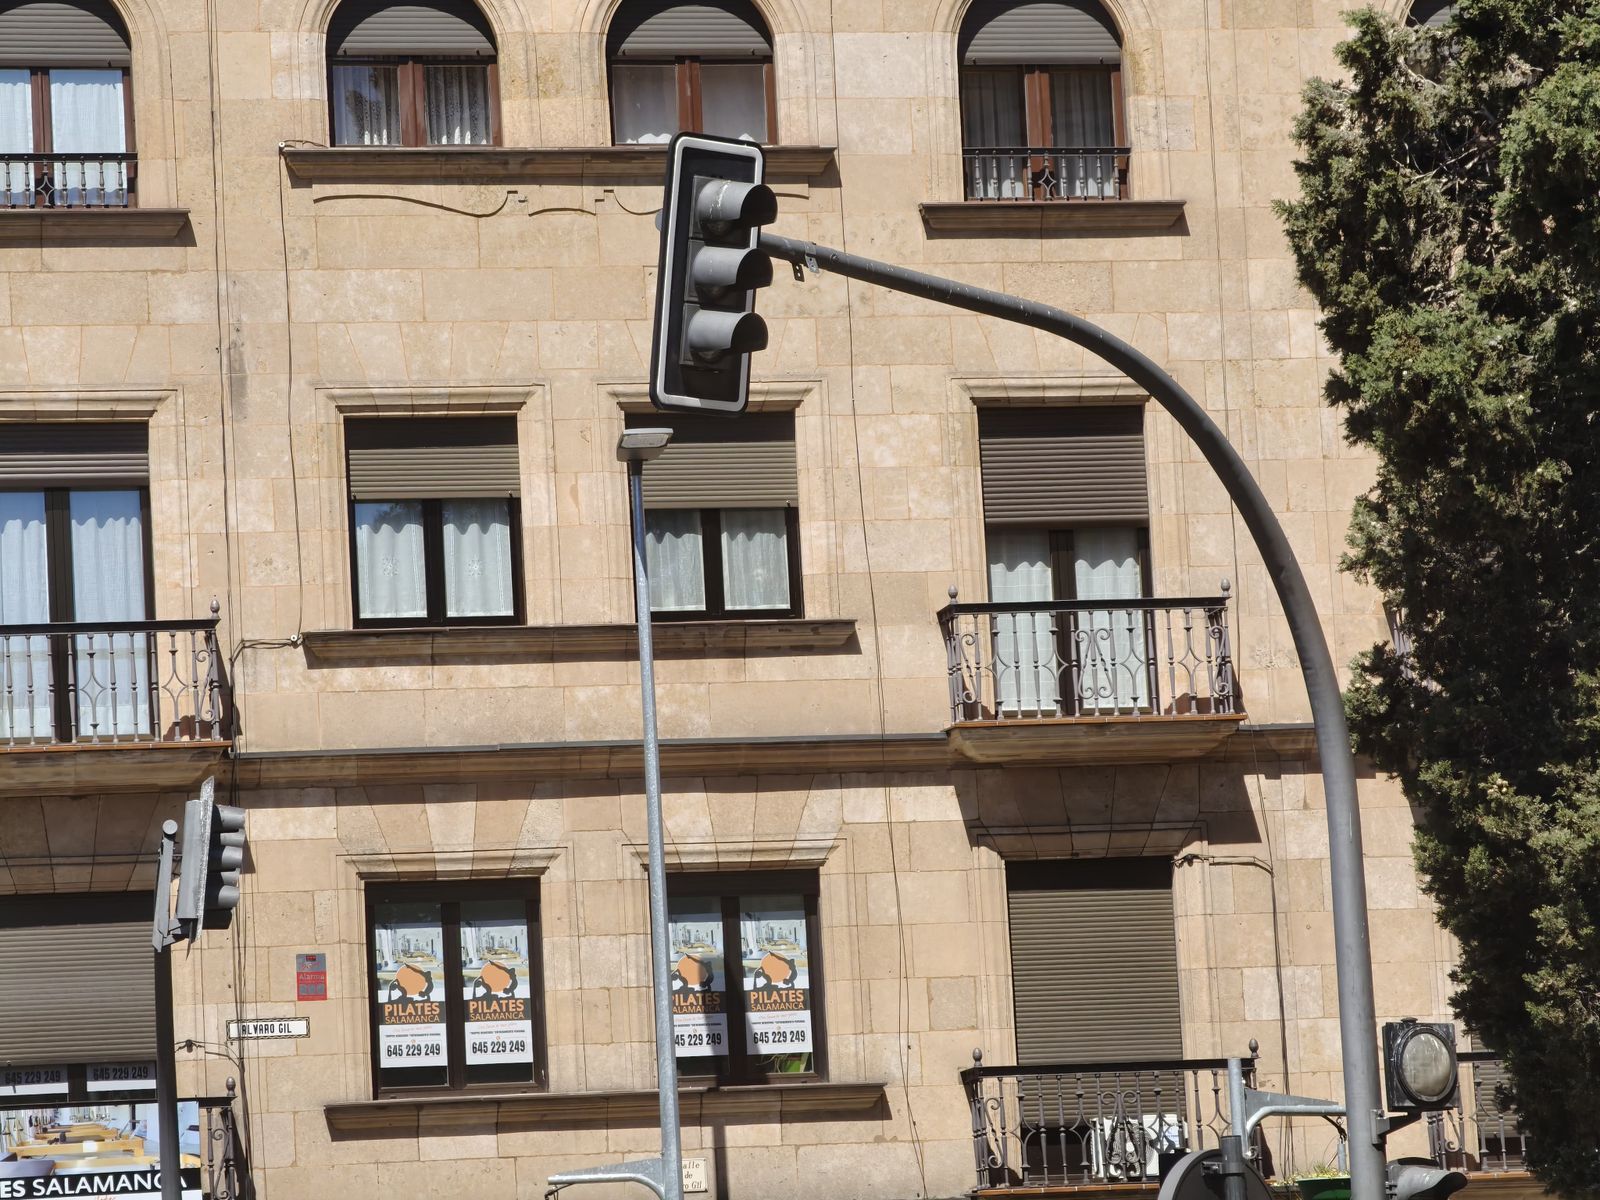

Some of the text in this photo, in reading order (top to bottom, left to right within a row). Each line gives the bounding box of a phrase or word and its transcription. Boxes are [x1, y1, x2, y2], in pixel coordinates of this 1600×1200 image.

[672, 993, 720, 1006] ILATES
[750, 990, 804, 1003] PILATES
[384, 1003, 440, 1016] PILATES
[469, 1000, 525, 1013] PILATES
[672, 1005, 720, 1014] ALAMANCA
[751, 1002, 805, 1012] SALAMANCA
[385, 1015, 440, 1024] SALAMANCA
[470, 1013, 525, 1021] SALAMANCA
[242, 1023, 292, 1035] ALVARO GIL
[675, 1033, 722, 1046] 45 229 249
[753, 1030, 805, 1044] 645 229 249
[387, 1043, 441, 1057] 645 229 249
[472, 1040, 525, 1054] 645 229 249
[25, 1071, 41, 1084] 229
[44, 1070, 61, 1083] 249
[113, 1067, 129, 1080] 229
[132, 1066, 148, 1079] 249
[683, 1161, 700, 1169] alle
[684, 1171, 693, 1179] de
